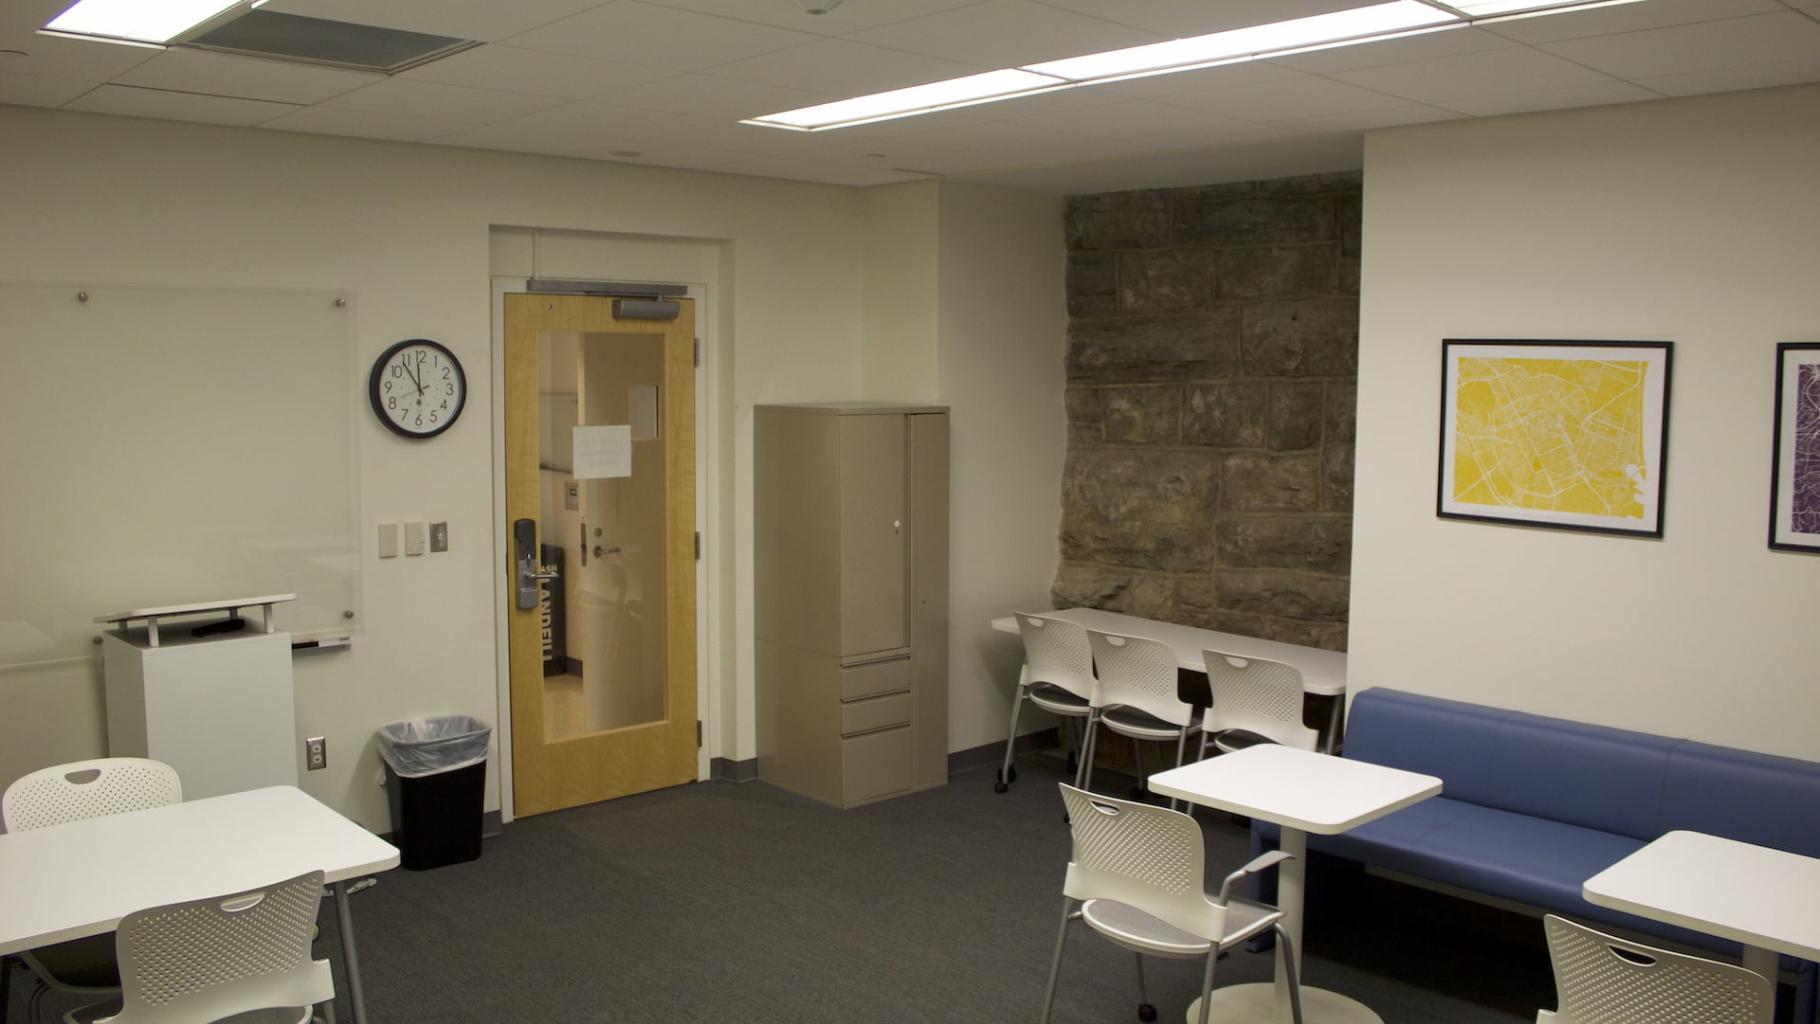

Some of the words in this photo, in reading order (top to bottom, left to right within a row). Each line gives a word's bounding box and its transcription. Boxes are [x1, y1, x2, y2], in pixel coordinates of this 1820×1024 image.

[401, 353, 411, 367] 11
[415, 350, 427, 364] 12
[391, 364, 403, 379] 10
[442, 366, 450, 380] 2
[384, 381, 393, 394] 9
[445, 383, 454, 396] 3
[388, 396, 397, 410] 8
[440, 398, 448, 411] 4
[401, 408, 409, 422] 7
[415, 414, 423, 427] 6
[429, 410, 438, 423] 5
